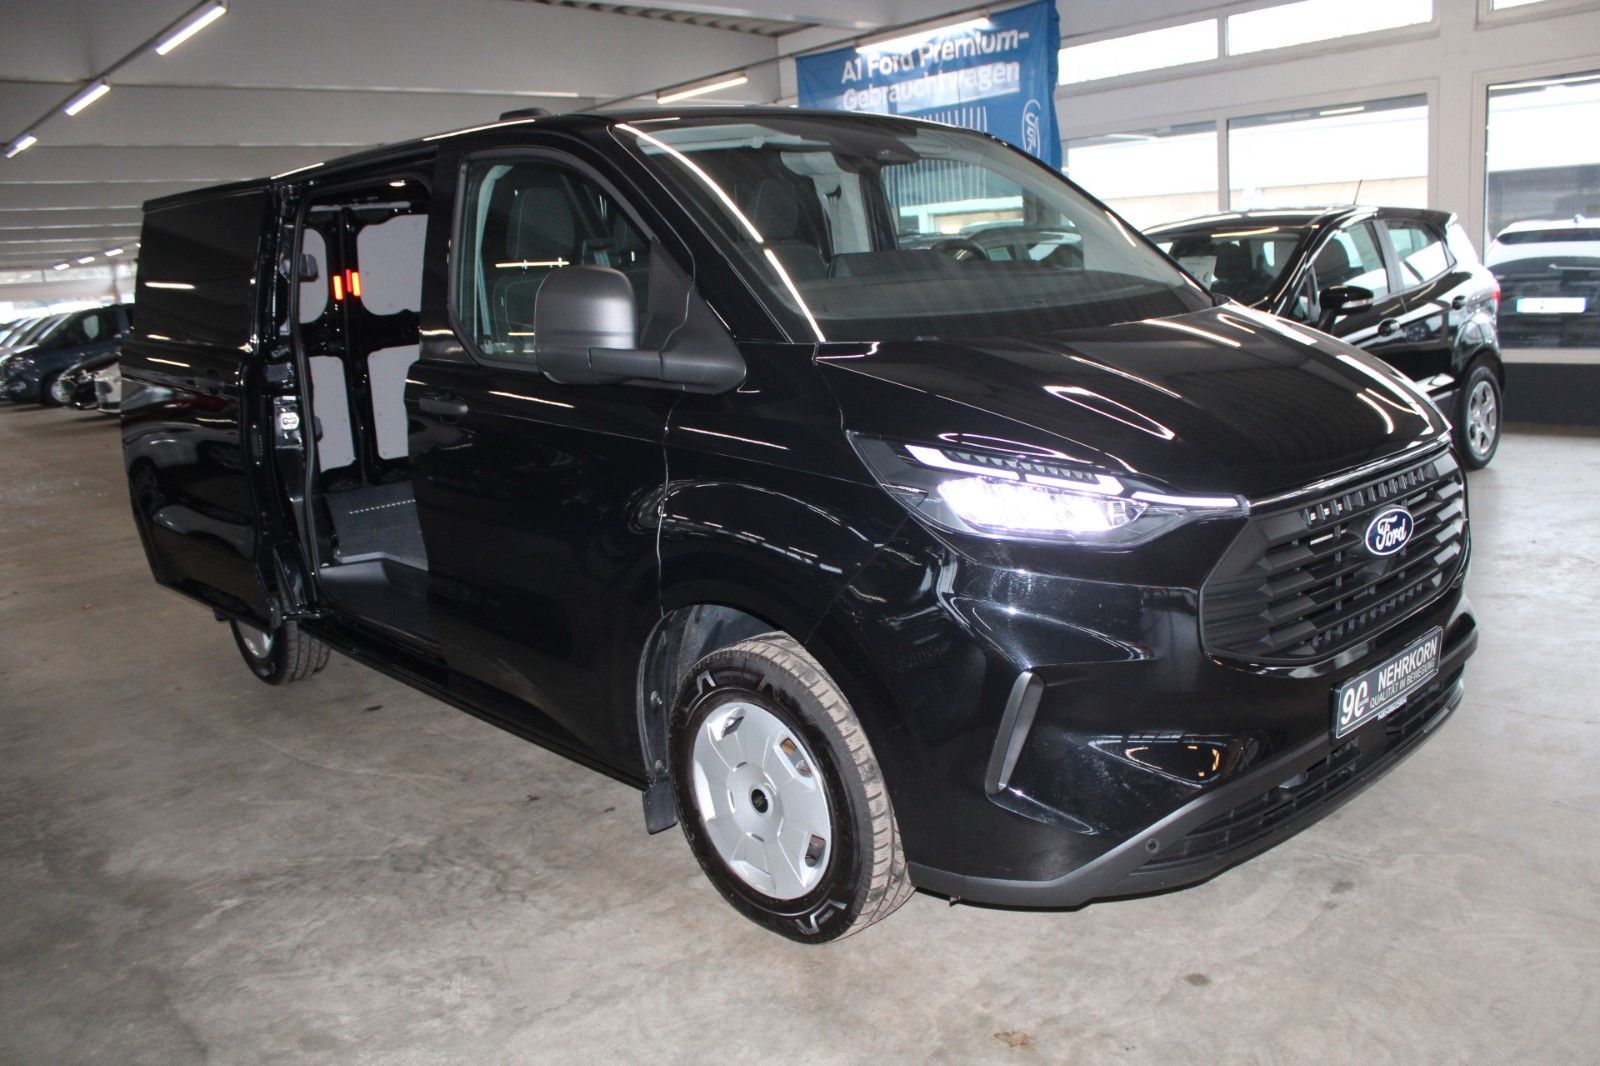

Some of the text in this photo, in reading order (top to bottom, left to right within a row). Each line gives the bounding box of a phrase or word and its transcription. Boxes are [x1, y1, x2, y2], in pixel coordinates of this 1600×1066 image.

[842, 29, 1029, 84] A1 Ford Premium-
[842, 62, 1019, 111] Gebrauchtwagen
[1376, 515, 1407, 550] Ford
[1370, 683, 1399, 708] QUALITÄT
[1399, 677, 1407, 690] IN
[1406, 658, 1436, 686] BEWEGUNG
[1378, 637, 1438, 692] NEHRKORN
